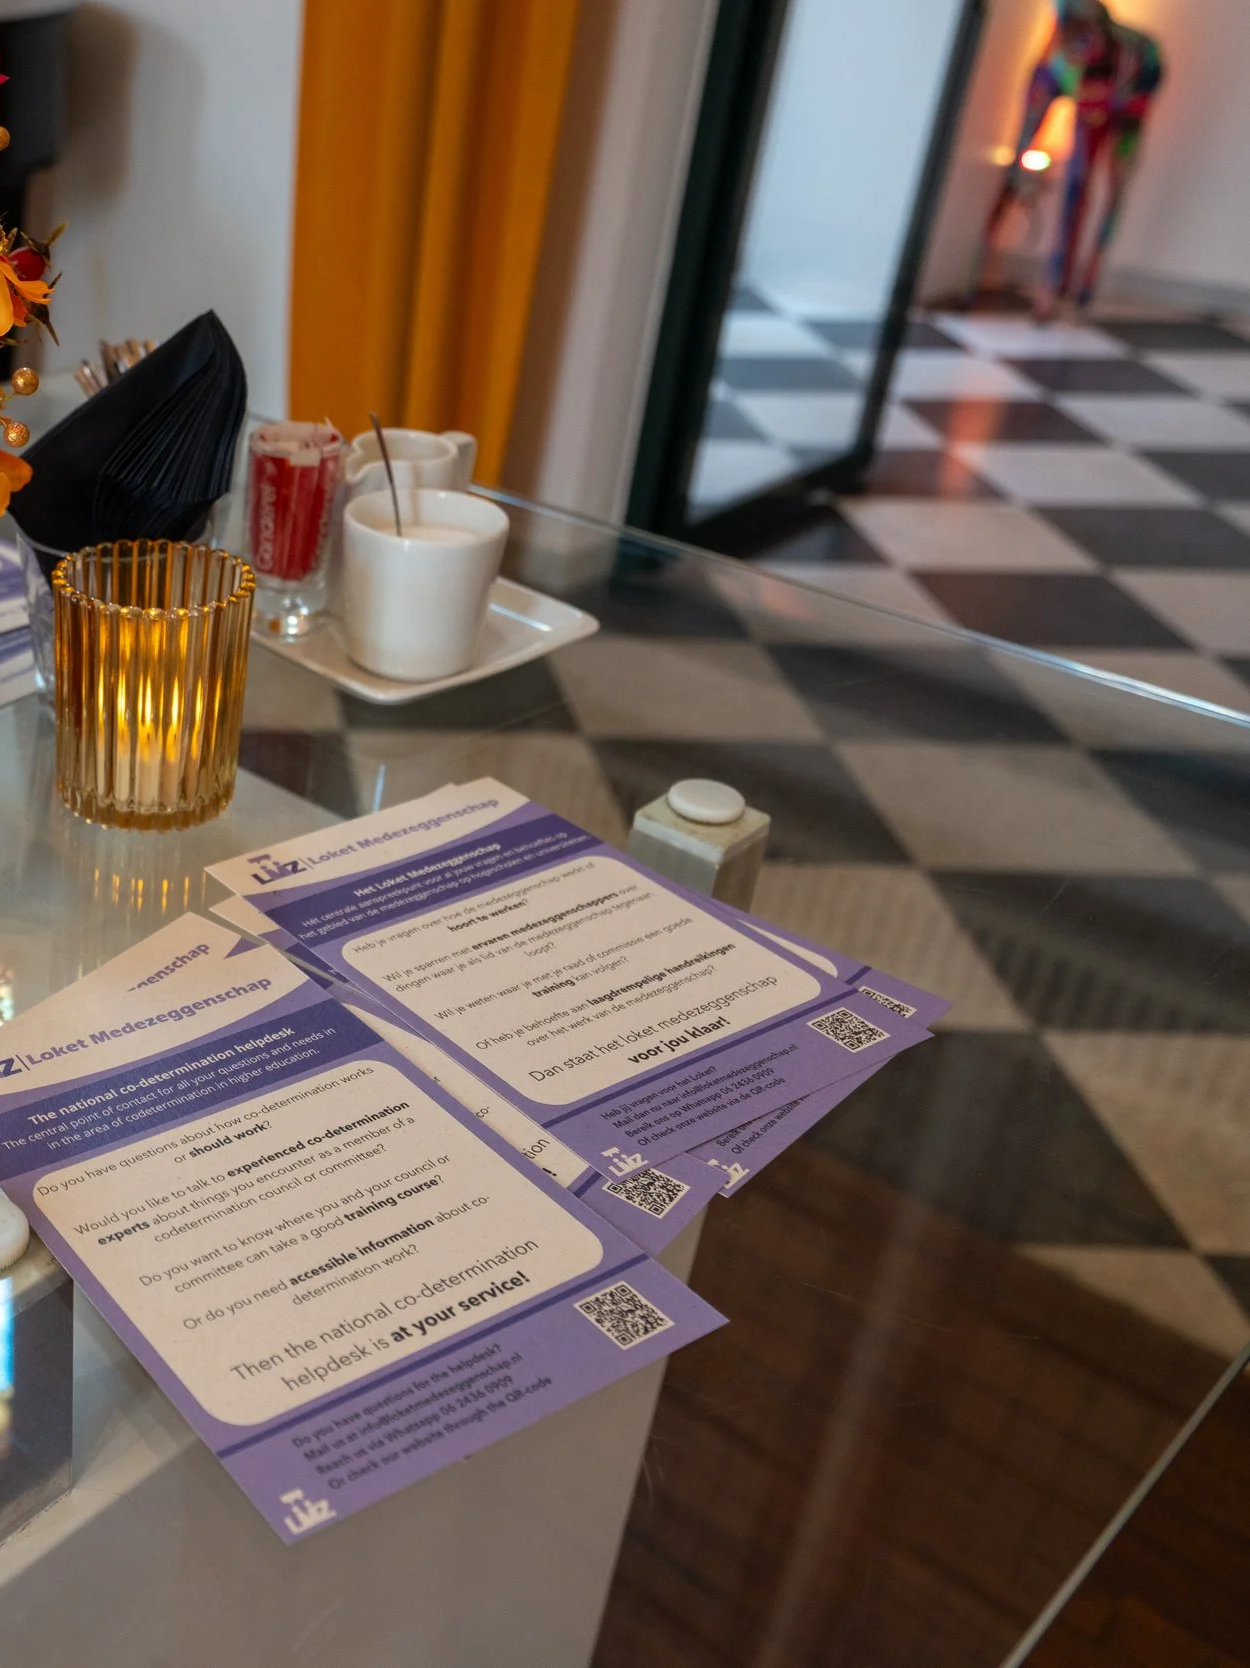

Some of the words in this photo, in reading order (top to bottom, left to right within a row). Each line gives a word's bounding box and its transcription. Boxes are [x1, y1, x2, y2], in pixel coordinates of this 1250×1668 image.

[305, 843, 359, 866] Loket
[354, 798, 500, 849] Medezeggenschap
[381, 970, 403, 982] Wil
[401, 968, 414, 978] je
[412, 954, 452, 972] sparren
[450, 946, 471, 958] met
[470, 932, 511, 951] ervaren
[508, 891, 619, 937] medezeggenschappers
[530, 977, 576, 998] training
[571, 971, 593, 982] kan
[591, 954, 627, 975] volgen?
[24, 1038, 90, 1066] Loket
[87, 977, 272, 1045] Medezeggenschap
[474, 1037, 492, 1050] Of
[488, 1031, 514, 1045] heb
[512, 1027, 525, 1038] je
[520, 1010, 571, 1032] behoefte
[568, 1002, 589, 1014] aan
[584, 970, 668, 1006] laagdrempelige
[662, 942, 736, 975] handreikingen
[527, 1064, 565, 1082] Dan
[562, 1048, 600, 1069] staat
[592, 1038, 625, 1055] het
[616, 1024, 660, 1045] loket
[655, 975, 778, 1030] medezeggenschap
[626, 1044, 664, 1064] voor
[658, 1034, 690, 1053] jou
[682, 1014, 731, 1039] klaar!
[0, 1137, 27, 1150] The
[26, 1121, 70, 1142] central
[68, 1111, 102, 1130] point
[100, 1104, 115, 1117] of
[114, 1091, 158, 1112] contact
[155, 1085, 174, 1097] for
[175, 1078, 191, 1090] all
[189, 1070, 216, 1087] your
[216, 1051, 271, 1076] questions
[269, 1041, 292, 1056] and
[290, 1031, 325, 1048] needs
[321, 1026, 337, 1036] in
[26, 1110, 58, 1125] The
[57, 1087, 119, 1116] national
[118, 1048, 236, 1095] co-determination
[232, 1026, 296, 1053] helpdesk
[45, 1140, 61, 1150] in
[59, 1132, 83, 1145] the
[82, 1122, 111, 1138] area
[109, 1115, 124, 1128] of
[124, 1085, 217, 1123] codetermination
[213, 1080, 229, 1090] in
[225, 1066, 263, 1085] higher
[263, 1047, 321, 1072] education.
[610, 1114, 635, 1129] Mail
[632, 1109, 652, 1121] dan
[648, 1103, 663, 1113] nu
[660, 1095, 682, 1108] naar
[622, 1120, 655, 1138] Bereik
[652, 1114, 670, 1125] ons
[667, 1109, 683, 1118] op
[676, 1091, 723, 1113] Whatsapp
[718, 1085, 734, 1095] 06
[729, 1075, 755, 1090] 2436
[750, 1066, 775, 1081] 0909
[32, 1184, 59, 1197] Do
[58, 1174, 86, 1191] you
[83, 1163, 118, 1179] have
[117, 1140, 179, 1168] questions
[178, 1125, 216, 1145] about
[212, 1116, 242, 1131] how
[242, 1079, 341, 1121] co-determination
[338, 1066, 375, 1084] works
[72, 1211, 120, 1235] Would
[120, 1204, 146, 1221] you
[144, 1195, 169, 1209] like
[169, 1189, 186, 1199] to
[185, 1178, 211, 1193] talk
[209, 1173, 226, 1184] to
[225, 1139, 307, 1178] experienced
[305, 1101, 410, 1146] co-determination
[96, 1220, 151, 1246] experts
[151, 1204, 191, 1225] about
[188, 1189, 231, 1210] things
[229, 1179, 255, 1197] you
[254, 1154, 316, 1184] encounter
[316, 1149, 333, 1159] as
[332, 1145, 342, 1154] a
[341, 1124, 391, 1150] member
[391, 1116, 406, 1129] of
[405, 1116, 416, 1124] a
[172, 1153, 187, 1164] or
[187, 1134, 234, 1158] should
[231, 1119, 272, 1140] work?
[742, 1130, 762, 1148] check
[760, 1120, 777, 1133] onze
[137, 1273, 163, 1287] Do
[161, 1262, 190, 1280] you
[188, 1247, 224, 1267] want
[221, 1242, 239, 1253] to
[235, 1226, 275, 1247] know
[273, 1210, 315, 1232] where
[313, 1200, 340, 1218] you
[338, 1187, 366, 1205] and
[363, 1177, 393, 1197] your
[392, 1157, 437, 1183] council
[435, 1153, 451, 1165] or
[153, 1197, 258, 1243] codetermination
[257, 1175, 303, 1201] council
[302, 1171, 317, 1183] or
[317, 1142, 387, 1177] committee?
[173, 1259, 244, 1293] committee
[244, 1249, 270, 1264] can
[268, 1237, 299, 1254] take
[299, 1232, 310, 1241] a
[309, 1214, 345, 1239] good
[342, 1195, 398, 1222] training
[395, 1173, 444, 1200] course?
[182, 1317, 202, 1329] Or
[204, 1308, 225, 1321] do
[225, 1297, 253, 1315] you
[252, 1278, 289, 1301] need
[288, 1251, 358, 1286] accessible
[354, 1218, 436, 1256] information
[434, 1202, 472, 1223] about
[470, 1196, 490, 1207] co-
[228, 1353, 285, 1380] Then
[282, 1338, 318, 1359] the
[317, 1300, 394, 1344] national
[392, 1239, 540, 1310] co-determination
[291, 1262, 382, 1306] determination
[380, 1242, 420, 1266] work?
[279, 1343, 372, 1391] helpdesk
[368, 1333, 391, 1351] is
[389, 1324, 414, 1343] at
[410, 1304, 457, 1336] your
[456, 1269, 531, 1312] service!
